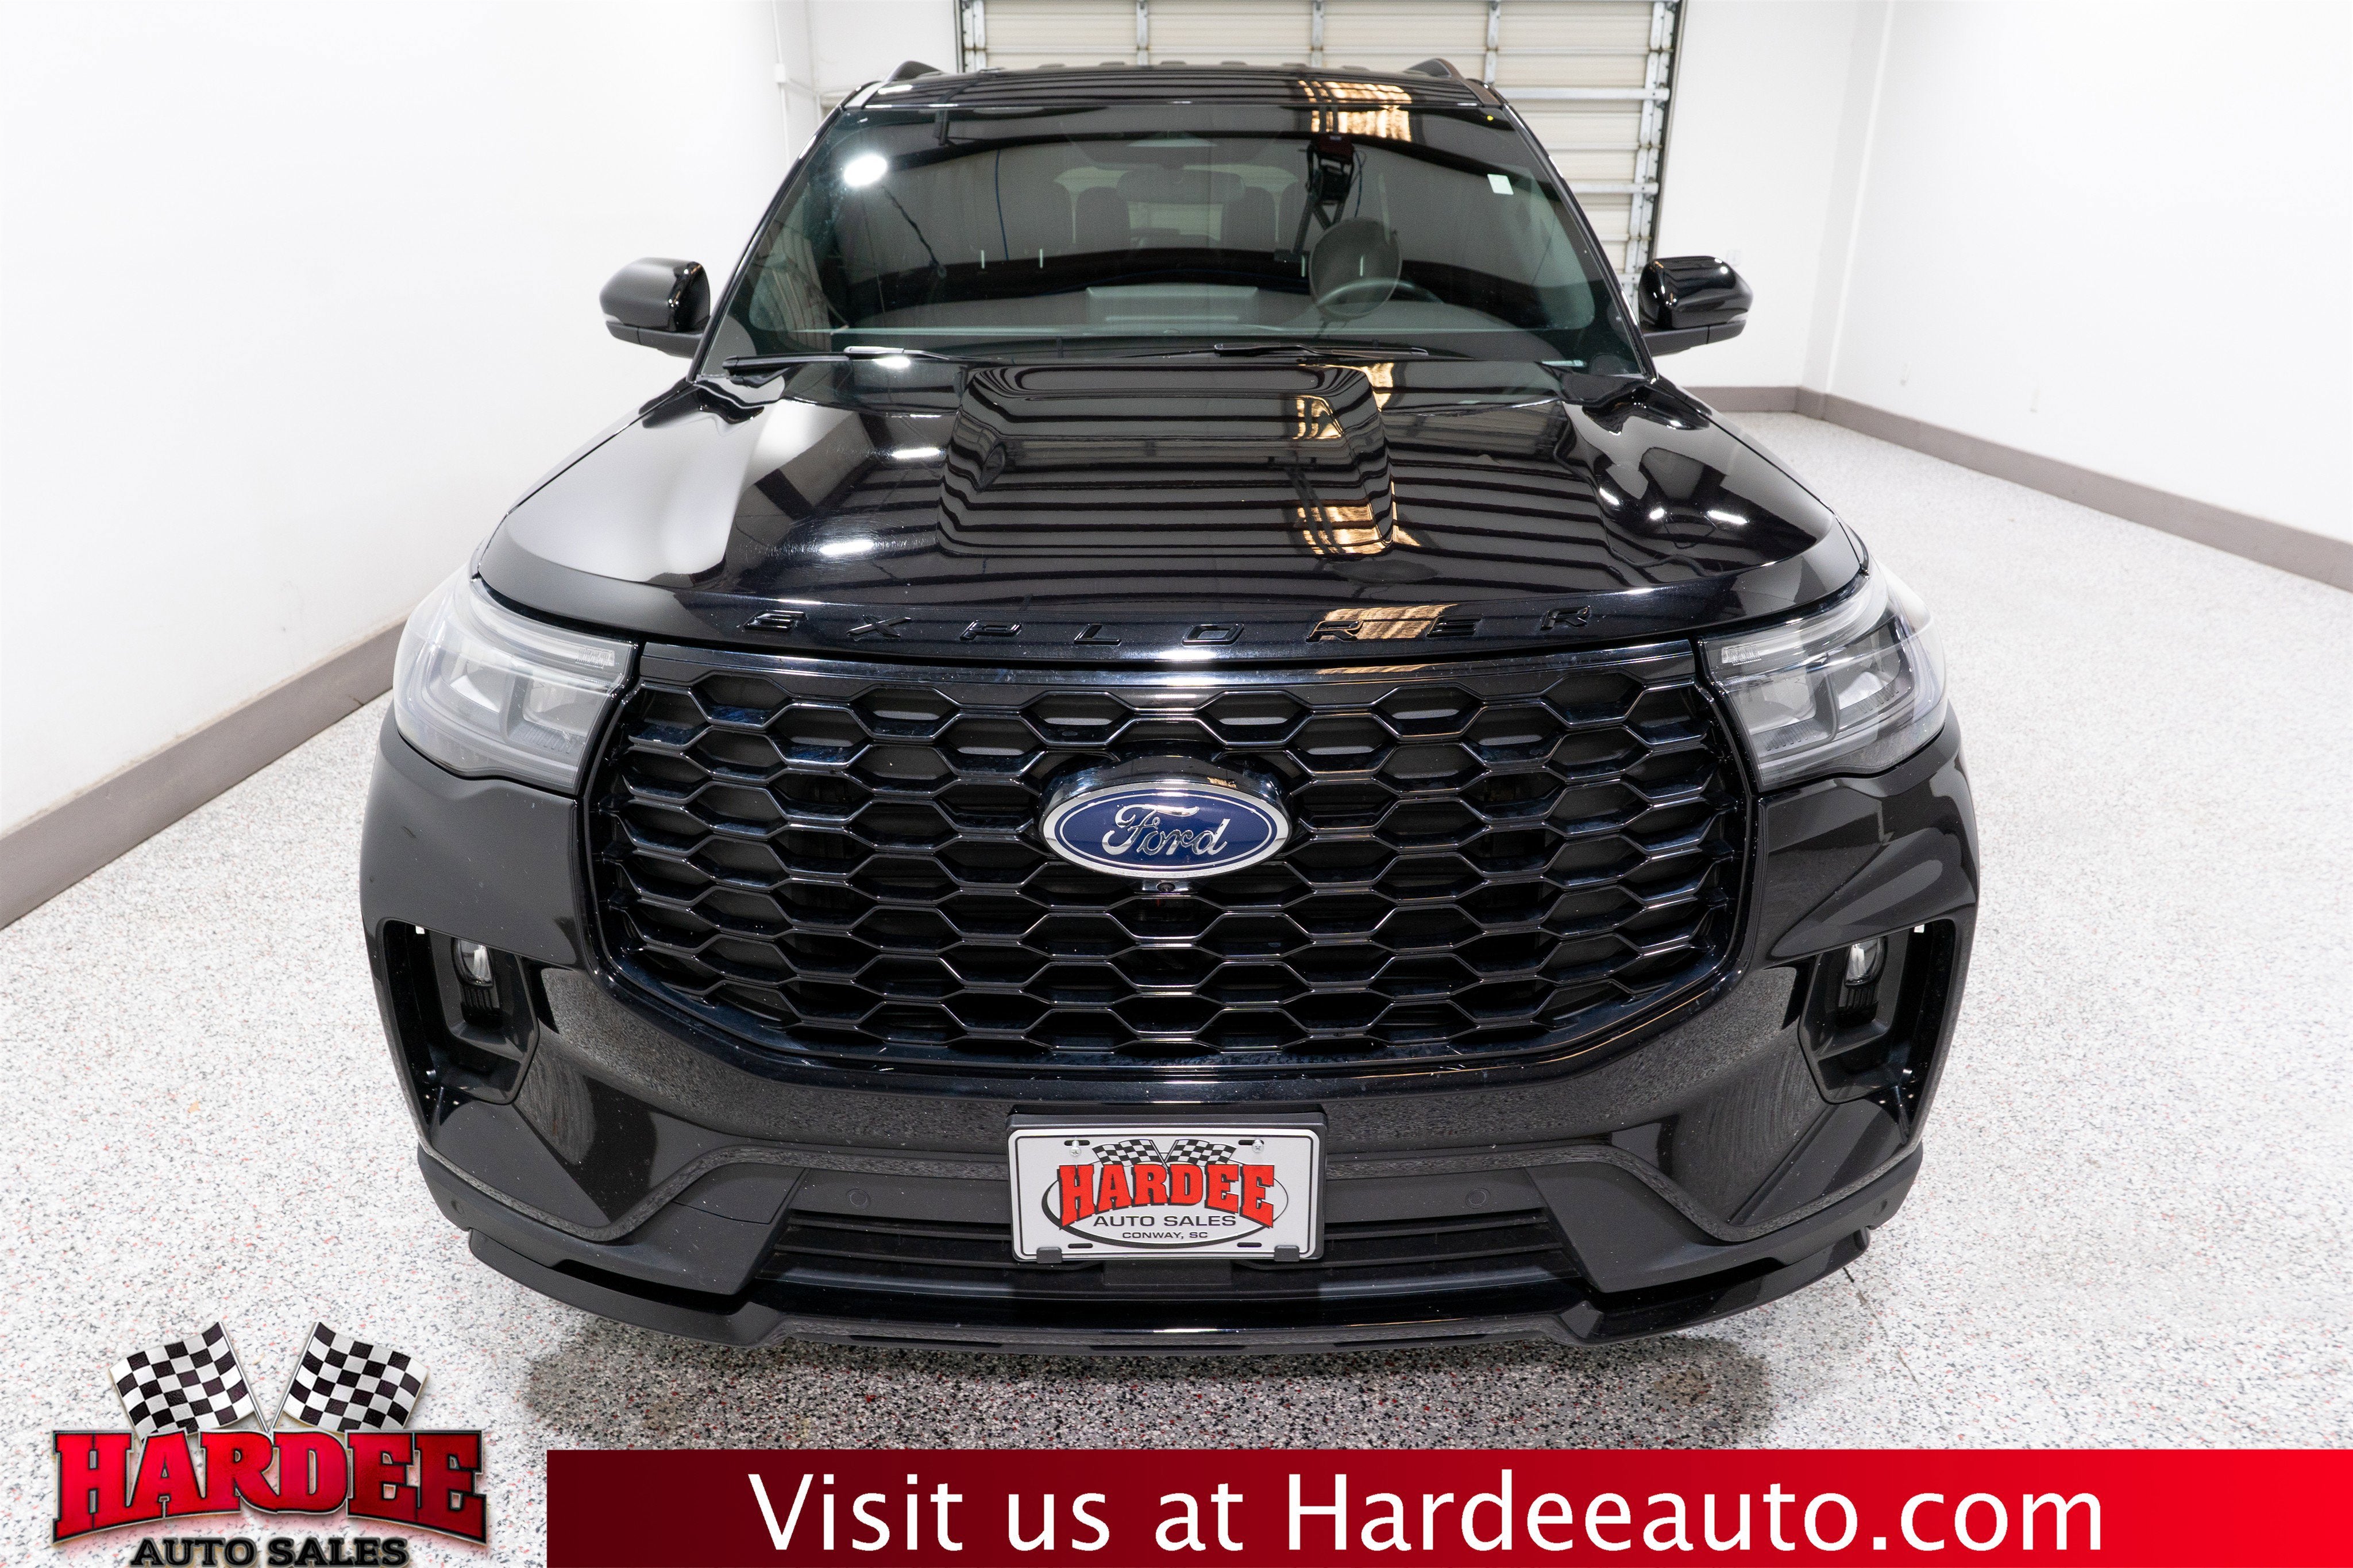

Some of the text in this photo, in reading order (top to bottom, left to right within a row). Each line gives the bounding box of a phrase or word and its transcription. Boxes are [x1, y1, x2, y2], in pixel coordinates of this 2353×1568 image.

[743, 605, 1592, 646] EXPLORER
[1102, 804, 1230, 856] Ford
[1057, 1164, 1275, 1230] HARDEE
[1093, 1215, 1236, 1227] AUTO SALES
[1122, 1231, 1184, 1239] CONWAY,
